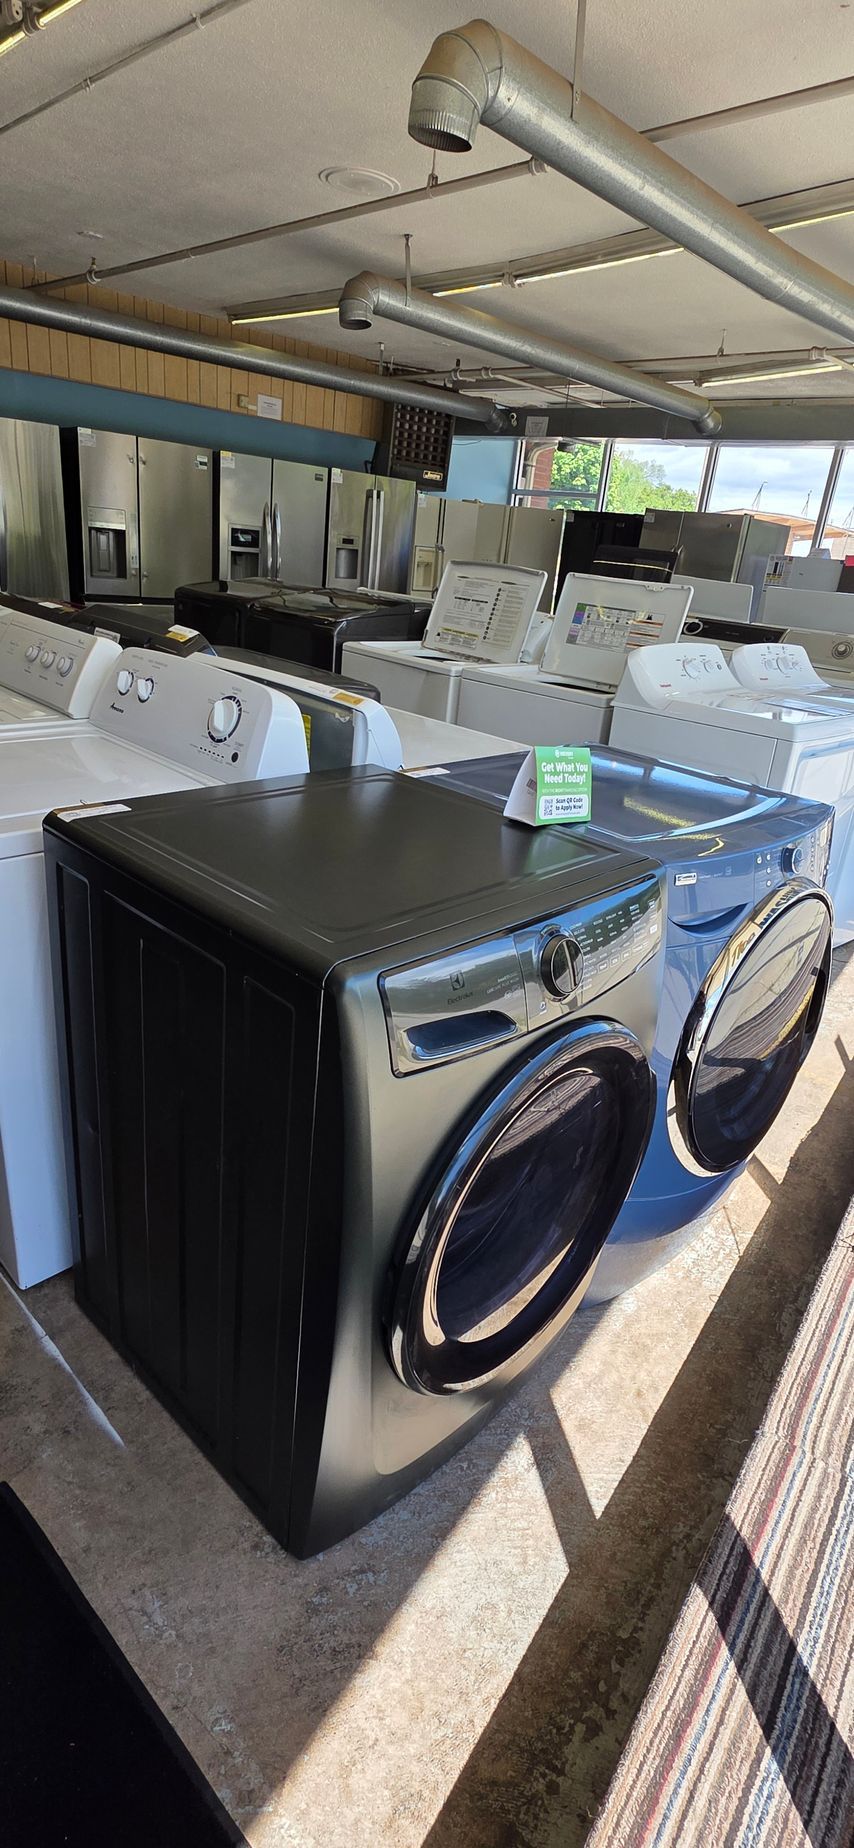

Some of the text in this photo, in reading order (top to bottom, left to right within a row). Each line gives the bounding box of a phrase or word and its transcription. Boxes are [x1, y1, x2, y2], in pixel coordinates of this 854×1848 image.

[542, 762, 588, 772] Get What You
[544, 774, 586, 784] Need Today!
